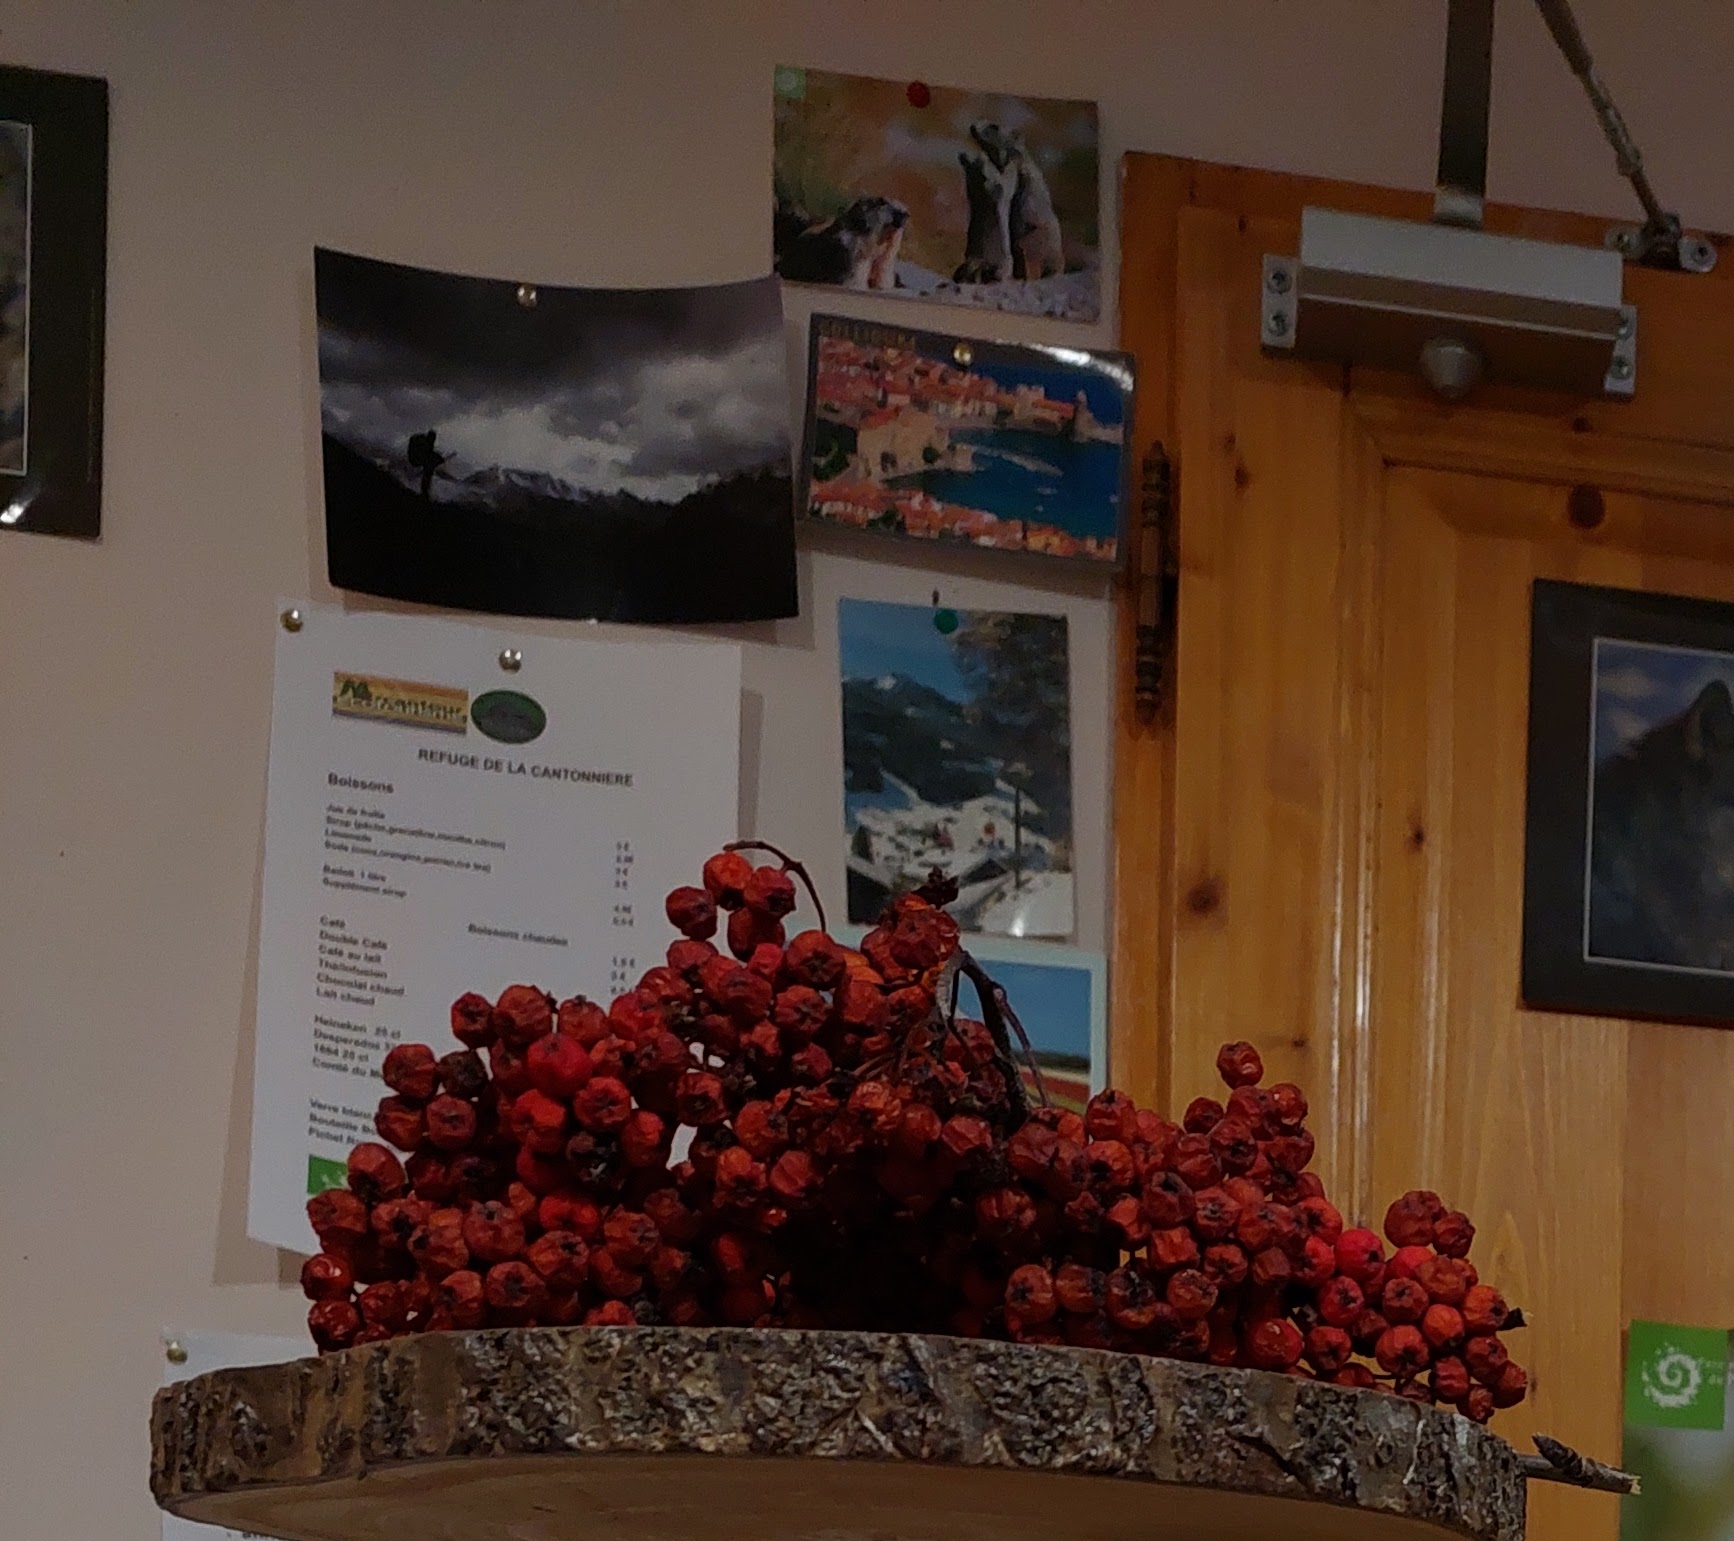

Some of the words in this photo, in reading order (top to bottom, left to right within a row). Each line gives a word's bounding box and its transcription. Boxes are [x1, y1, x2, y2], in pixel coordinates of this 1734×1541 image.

[418, 748, 480, 770] REFUGE
[484, 757, 504, 772] DE
[507, 760, 528, 776] LA
[328, 773, 394, 794] Boissons
